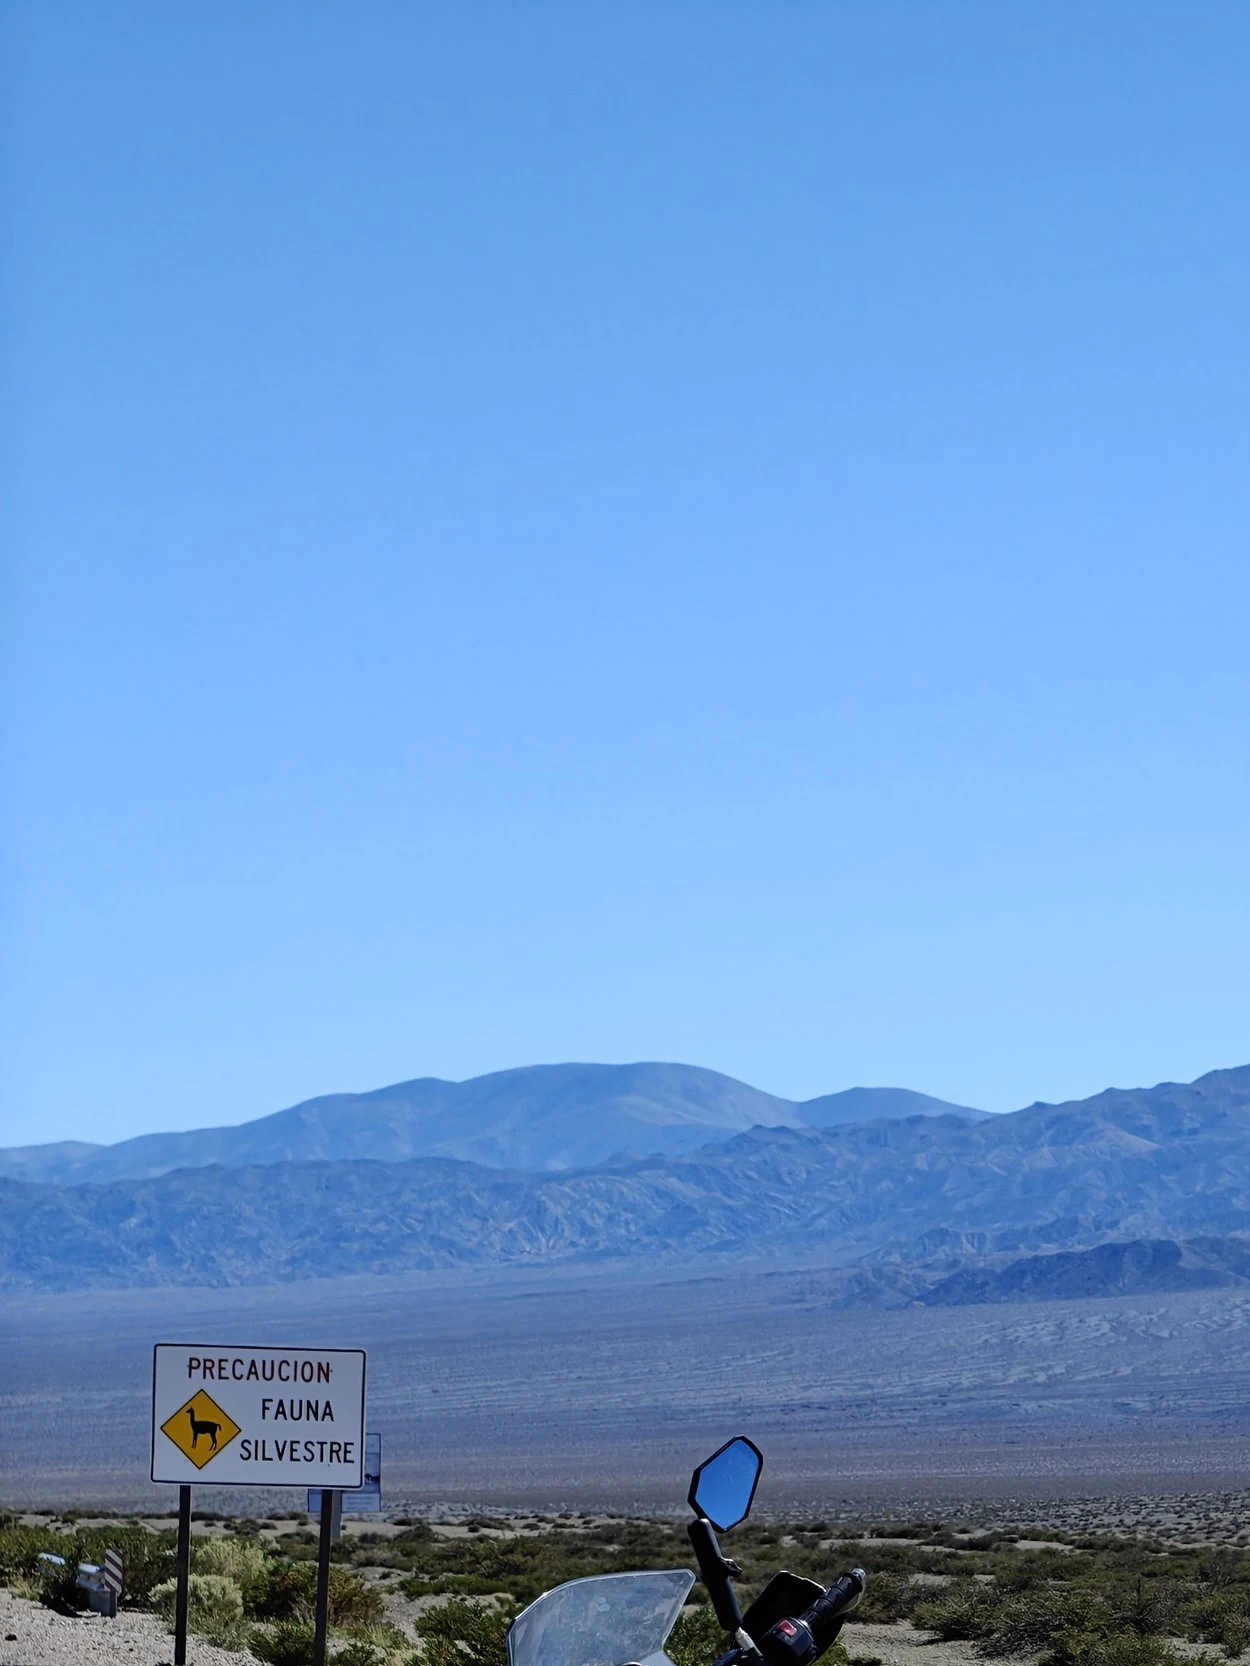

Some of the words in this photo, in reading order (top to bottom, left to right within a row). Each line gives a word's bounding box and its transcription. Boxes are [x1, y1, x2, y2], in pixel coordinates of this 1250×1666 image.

[188, 1357, 330, 1383] PRECAUCION
[261, 1398, 335, 1422] FAUNA
[240, 1439, 355, 1463] SILVESTRE
